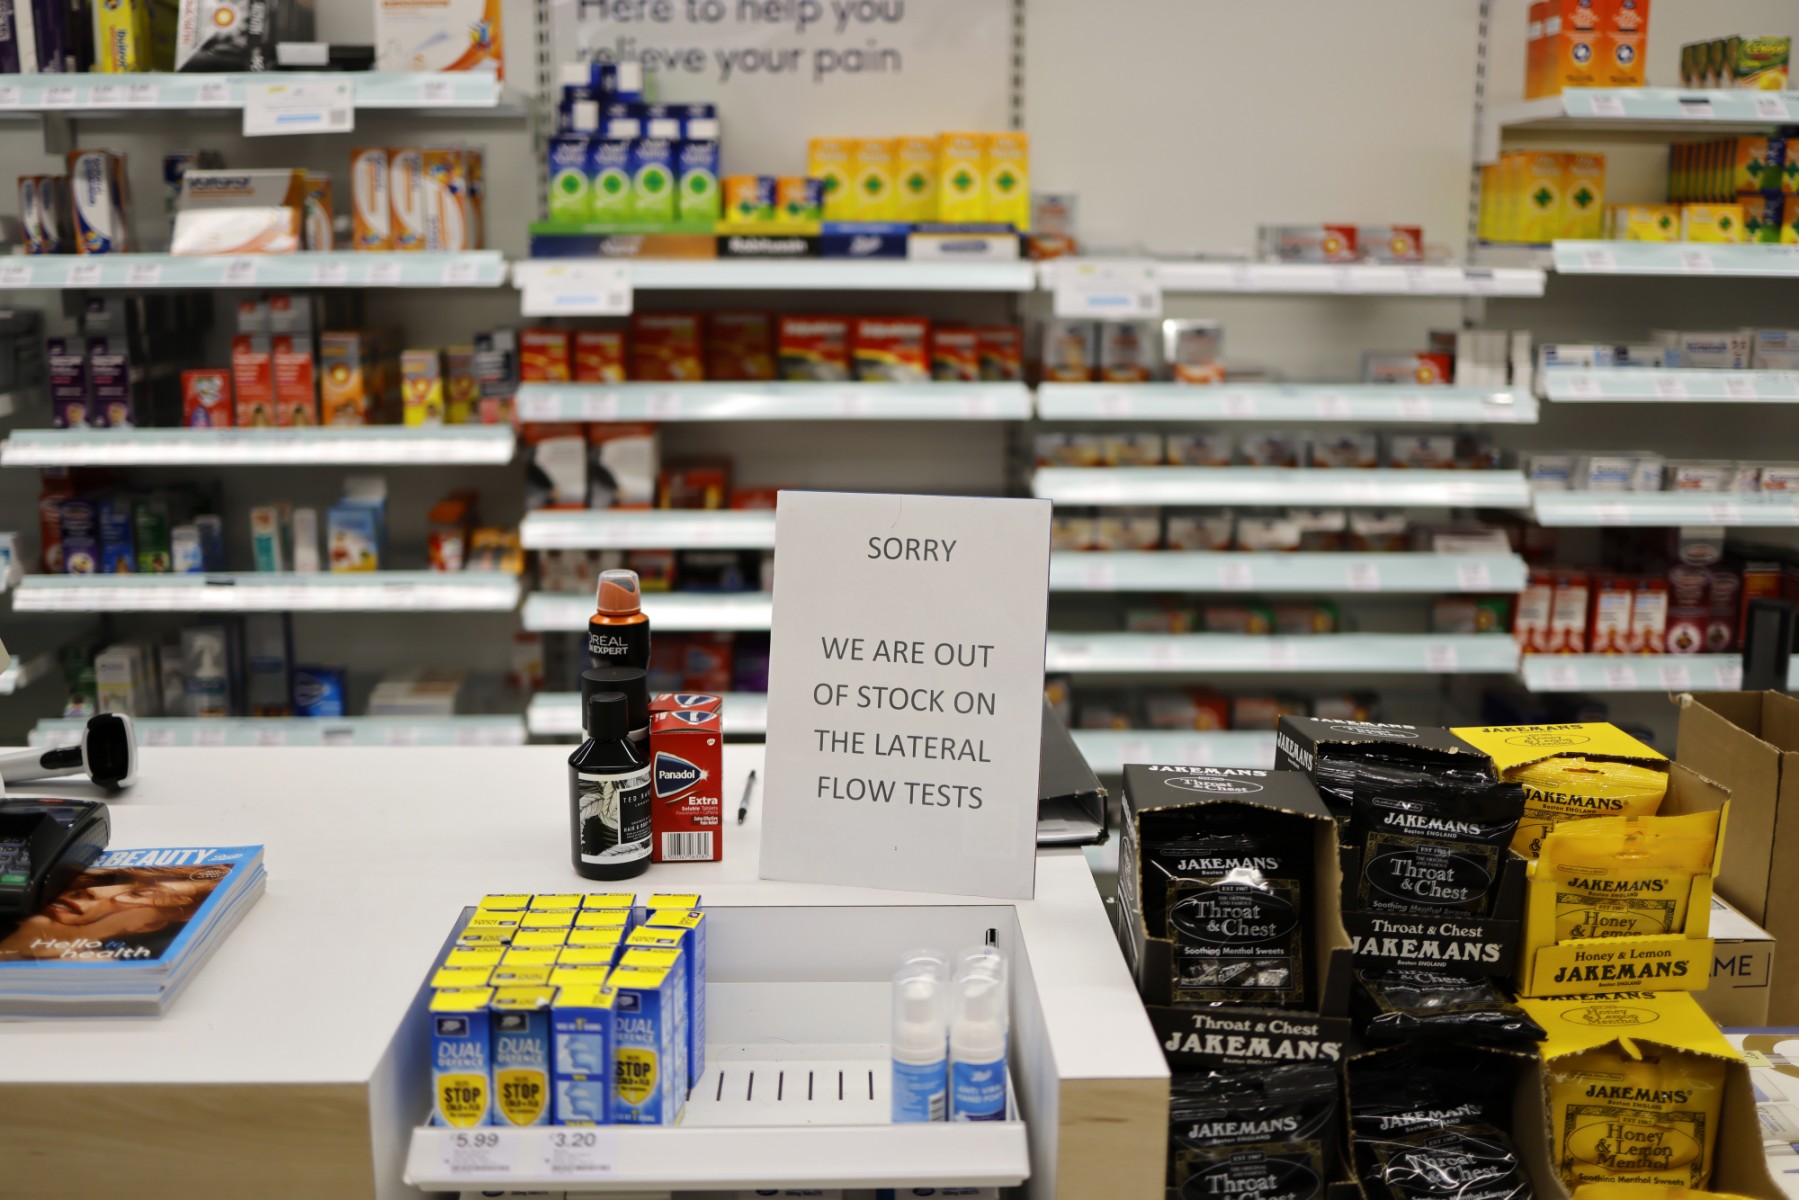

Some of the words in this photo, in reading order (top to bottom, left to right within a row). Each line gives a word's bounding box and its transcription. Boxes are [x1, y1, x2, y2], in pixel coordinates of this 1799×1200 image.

[577, 0, 676, 21] Here
[685, 0, 727, 21] to
[736, 0, 824, 34] help
[830, 0, 904, 34] you
[577, 36, 707, 72] relieve
[715, 48, 806, 84] your
[814, 38, 904, 84] pain
[868, 537, 957, 562] SORRY
[594, 646, 629, 655] EXPERT
[821, 637, 865, 661] WE
[872, 639, 925, 664] ARE
[934, 642, 994, 668] OUT
[813, 683, 849, 706] OF
[856, 685, 945, 712] STOCK
[953, 691, 996, 715] ON
[814, 729, 865, 755] THE
[875, 733, 991, 762] LATERAL
[1277, 732, 1313, 771] JAKEMANS
[658, 770, 695, 779] Panadol
[1147, 765, 1268, 777] JAKEMANS
[688, 797, 718, 805] Extra
[818, 776, 896, 803] FLOW
[904, 782, 983, 809] TESTS
[1525, 788, 1623, 811] JAKEMANS
[1542, 803, 1563, 811] Boston
[1565, 806, 1597, 814] ENGLAND
[1384, 812, 1481, 835] JAKEMANS
[1403, 828, 1425, 836] Boston
[1426, 830, 1457, 839] ENGLAND
[107, 848, 218, 867] BEAUTY
[1177, 857, 1279, 870] JAKEMANS
[1390, 858, 1454, 882] Throat
[1567, 878, 1664, 892] JAKEMANS
[1195, 900, 1261, 919] Throat
[1372, 900, 1408, 911] Soothing
[1371, 919, 1424, 934] Throat
[1426, 926, 1437, 935] &
[1439, 923, 1483, 938] Chest
[1583, 910, 1637, 931] Honey
[1568, 924, 1587, 938] &
[1588, 926, 1642, 939] Lemon
[31, 938, 104, 950] Hello
[60, 946, 152, 960] health
[1184, 947, 1221, 955] Soothing
[1222, 946, 1254, 955] Menthol
[1255, 947, 1284, 955] Sweets
[1352, 936, 1503, 962] JAKEMANS
[1574, 951, 1614, 963] Honey
[1617, 951, 1627, 959] &
[1630, 948, 1672, 960] Lemon
[1554, 960, 1689, 983] JAKEMANS
[1709, 955, 1753, 983] ME
[1616, 979, 1642, 987] ENGLAND
[1192, 1015, 1251, 1032] Throat
[1254, 1022, 1265, 1032] &
[1269, 1020, 1318, 1036] Chest
[438, 1041, 483, 1058] DUAL
[498, 1037, 543, 1054] DUAL
[1165, 1032, 1342, 1061] JAKEMANS
[438, 1057, 484, 1066] DEFENCE
[617, 1061, 651, 1077] STOP
[444, 1087, 481, 1103] STOP
[503, 1083, 539, 1100] STOP
[1585, 1084, 1688, 1104] JAKEMANS
[1380, 1104, 1482, 1130] JAKEMANS
[1189, 1116, 1298, 1138] JAKEMANS
[1405, 1124, 1428, 1132] Boston
[1606, 1123, 1664, 1146] Honey
[1595, 1138, 1611, 1153] &
[1615, 1140, 1673, 1157] Lemon
[1405, 1153, 1476, 1169] Throat
[1596, 1153, 1669, 1169] Menthol
[1205, 1173, 1278, 1194] Throat
[1617, 1174, 1651, 1184] Menthol
[1653, 1176, 1685, 1187] Sweets
